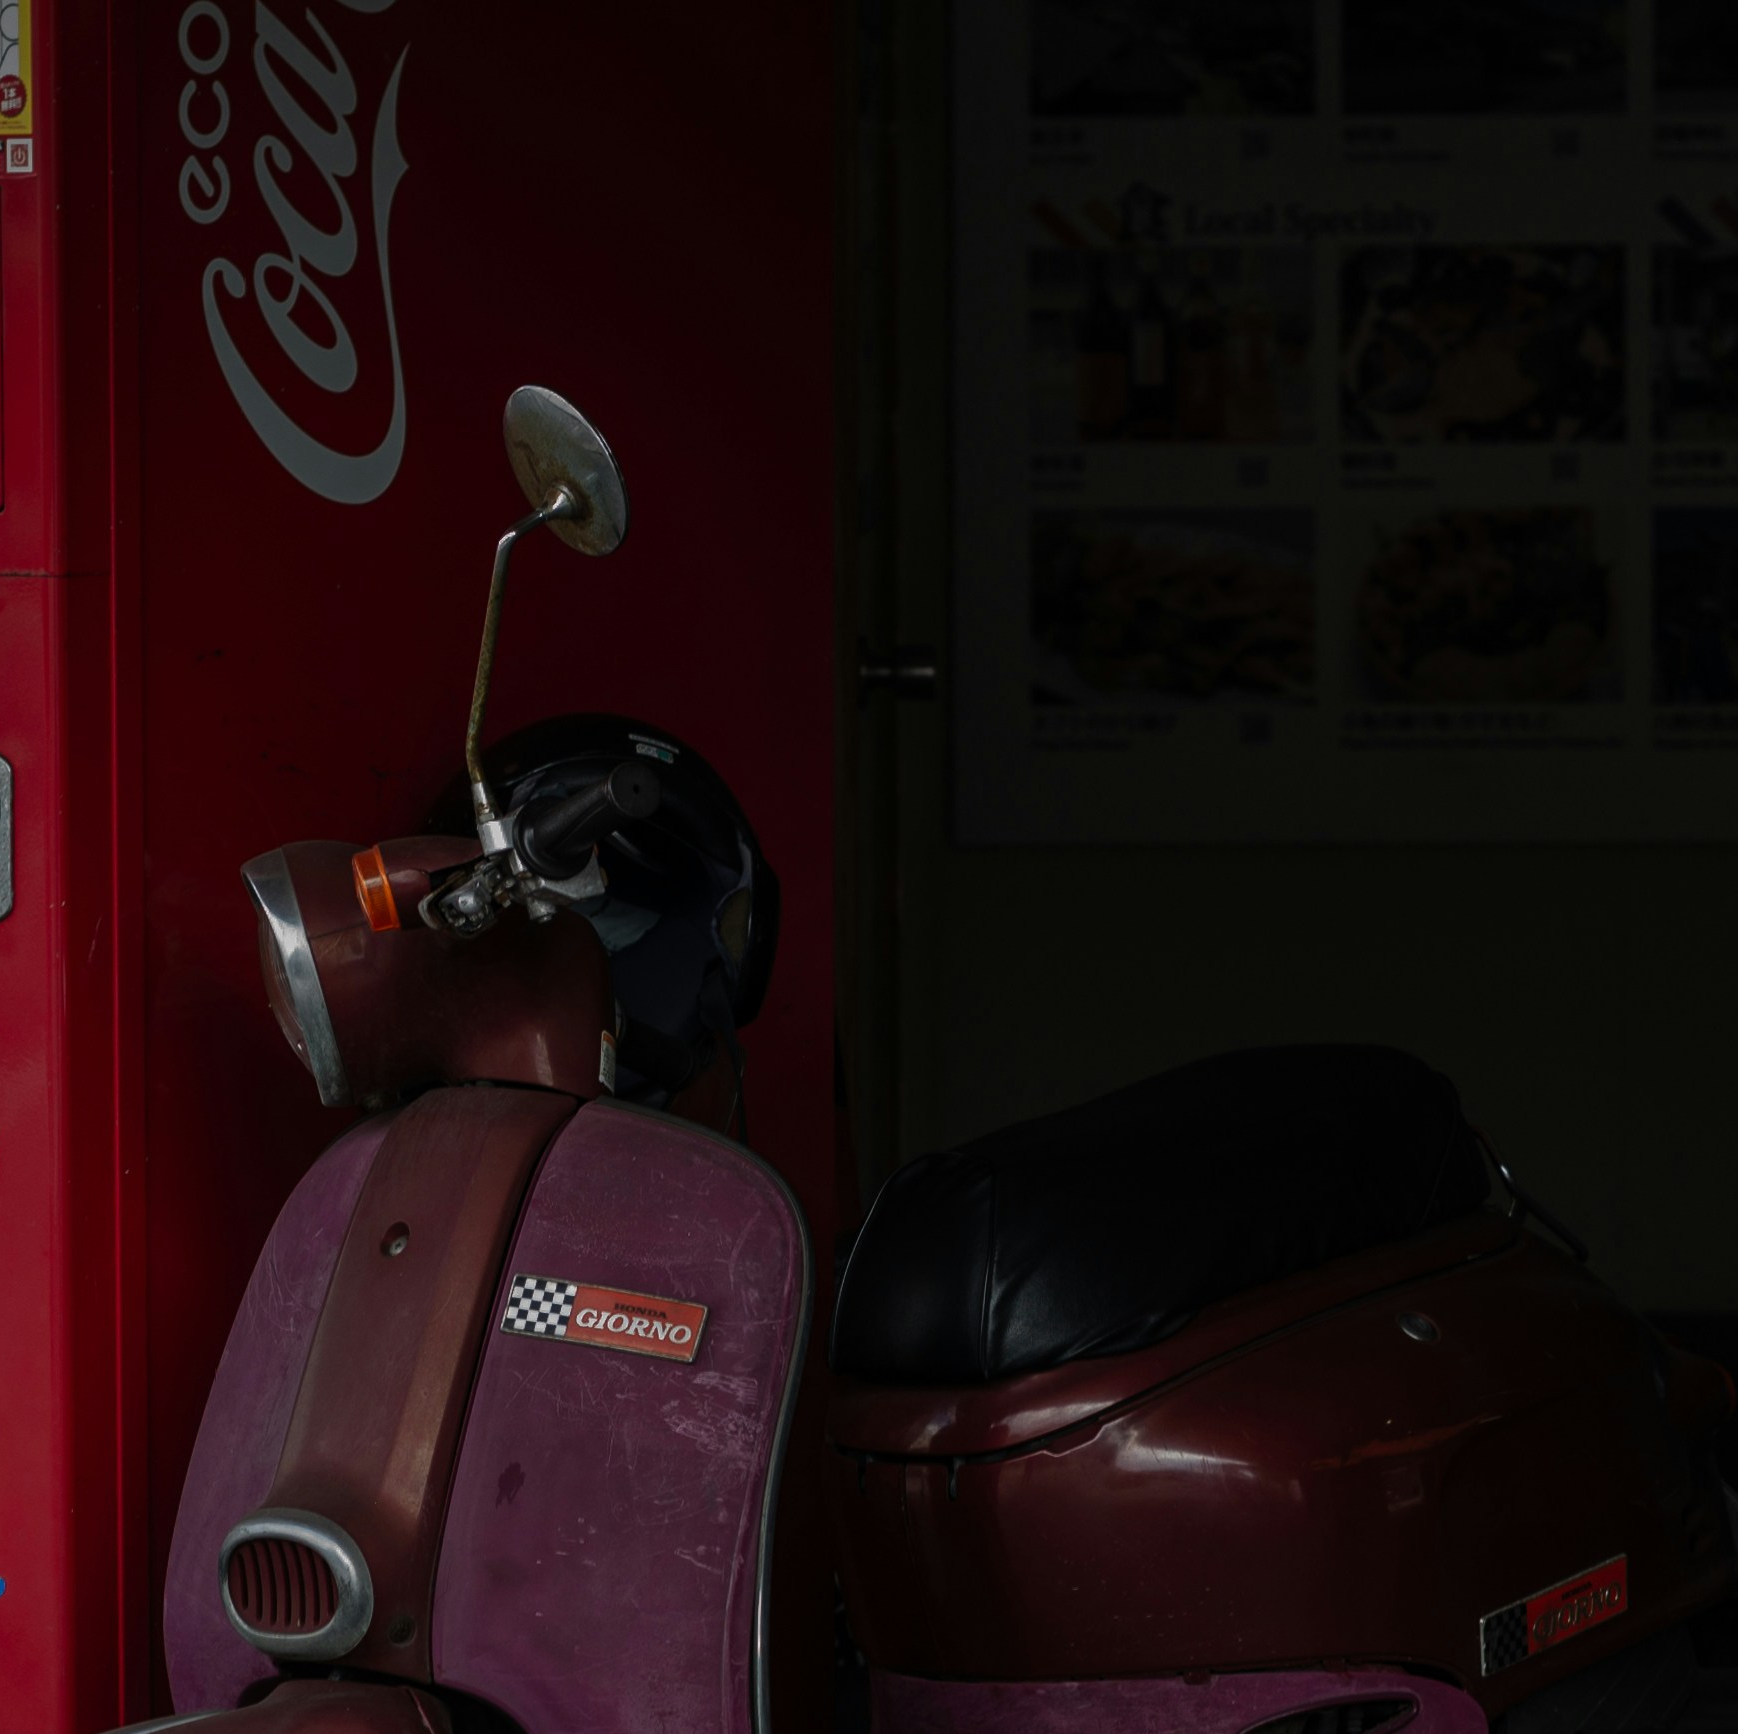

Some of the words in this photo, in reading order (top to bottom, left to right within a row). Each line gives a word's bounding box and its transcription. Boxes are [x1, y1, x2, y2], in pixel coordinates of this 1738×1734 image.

[575, 1307, 692, 1345] GIORNO
[614, 1303, 668, 1319] HONDA
[1532, 1580, 1623, 1643] GIORNO
